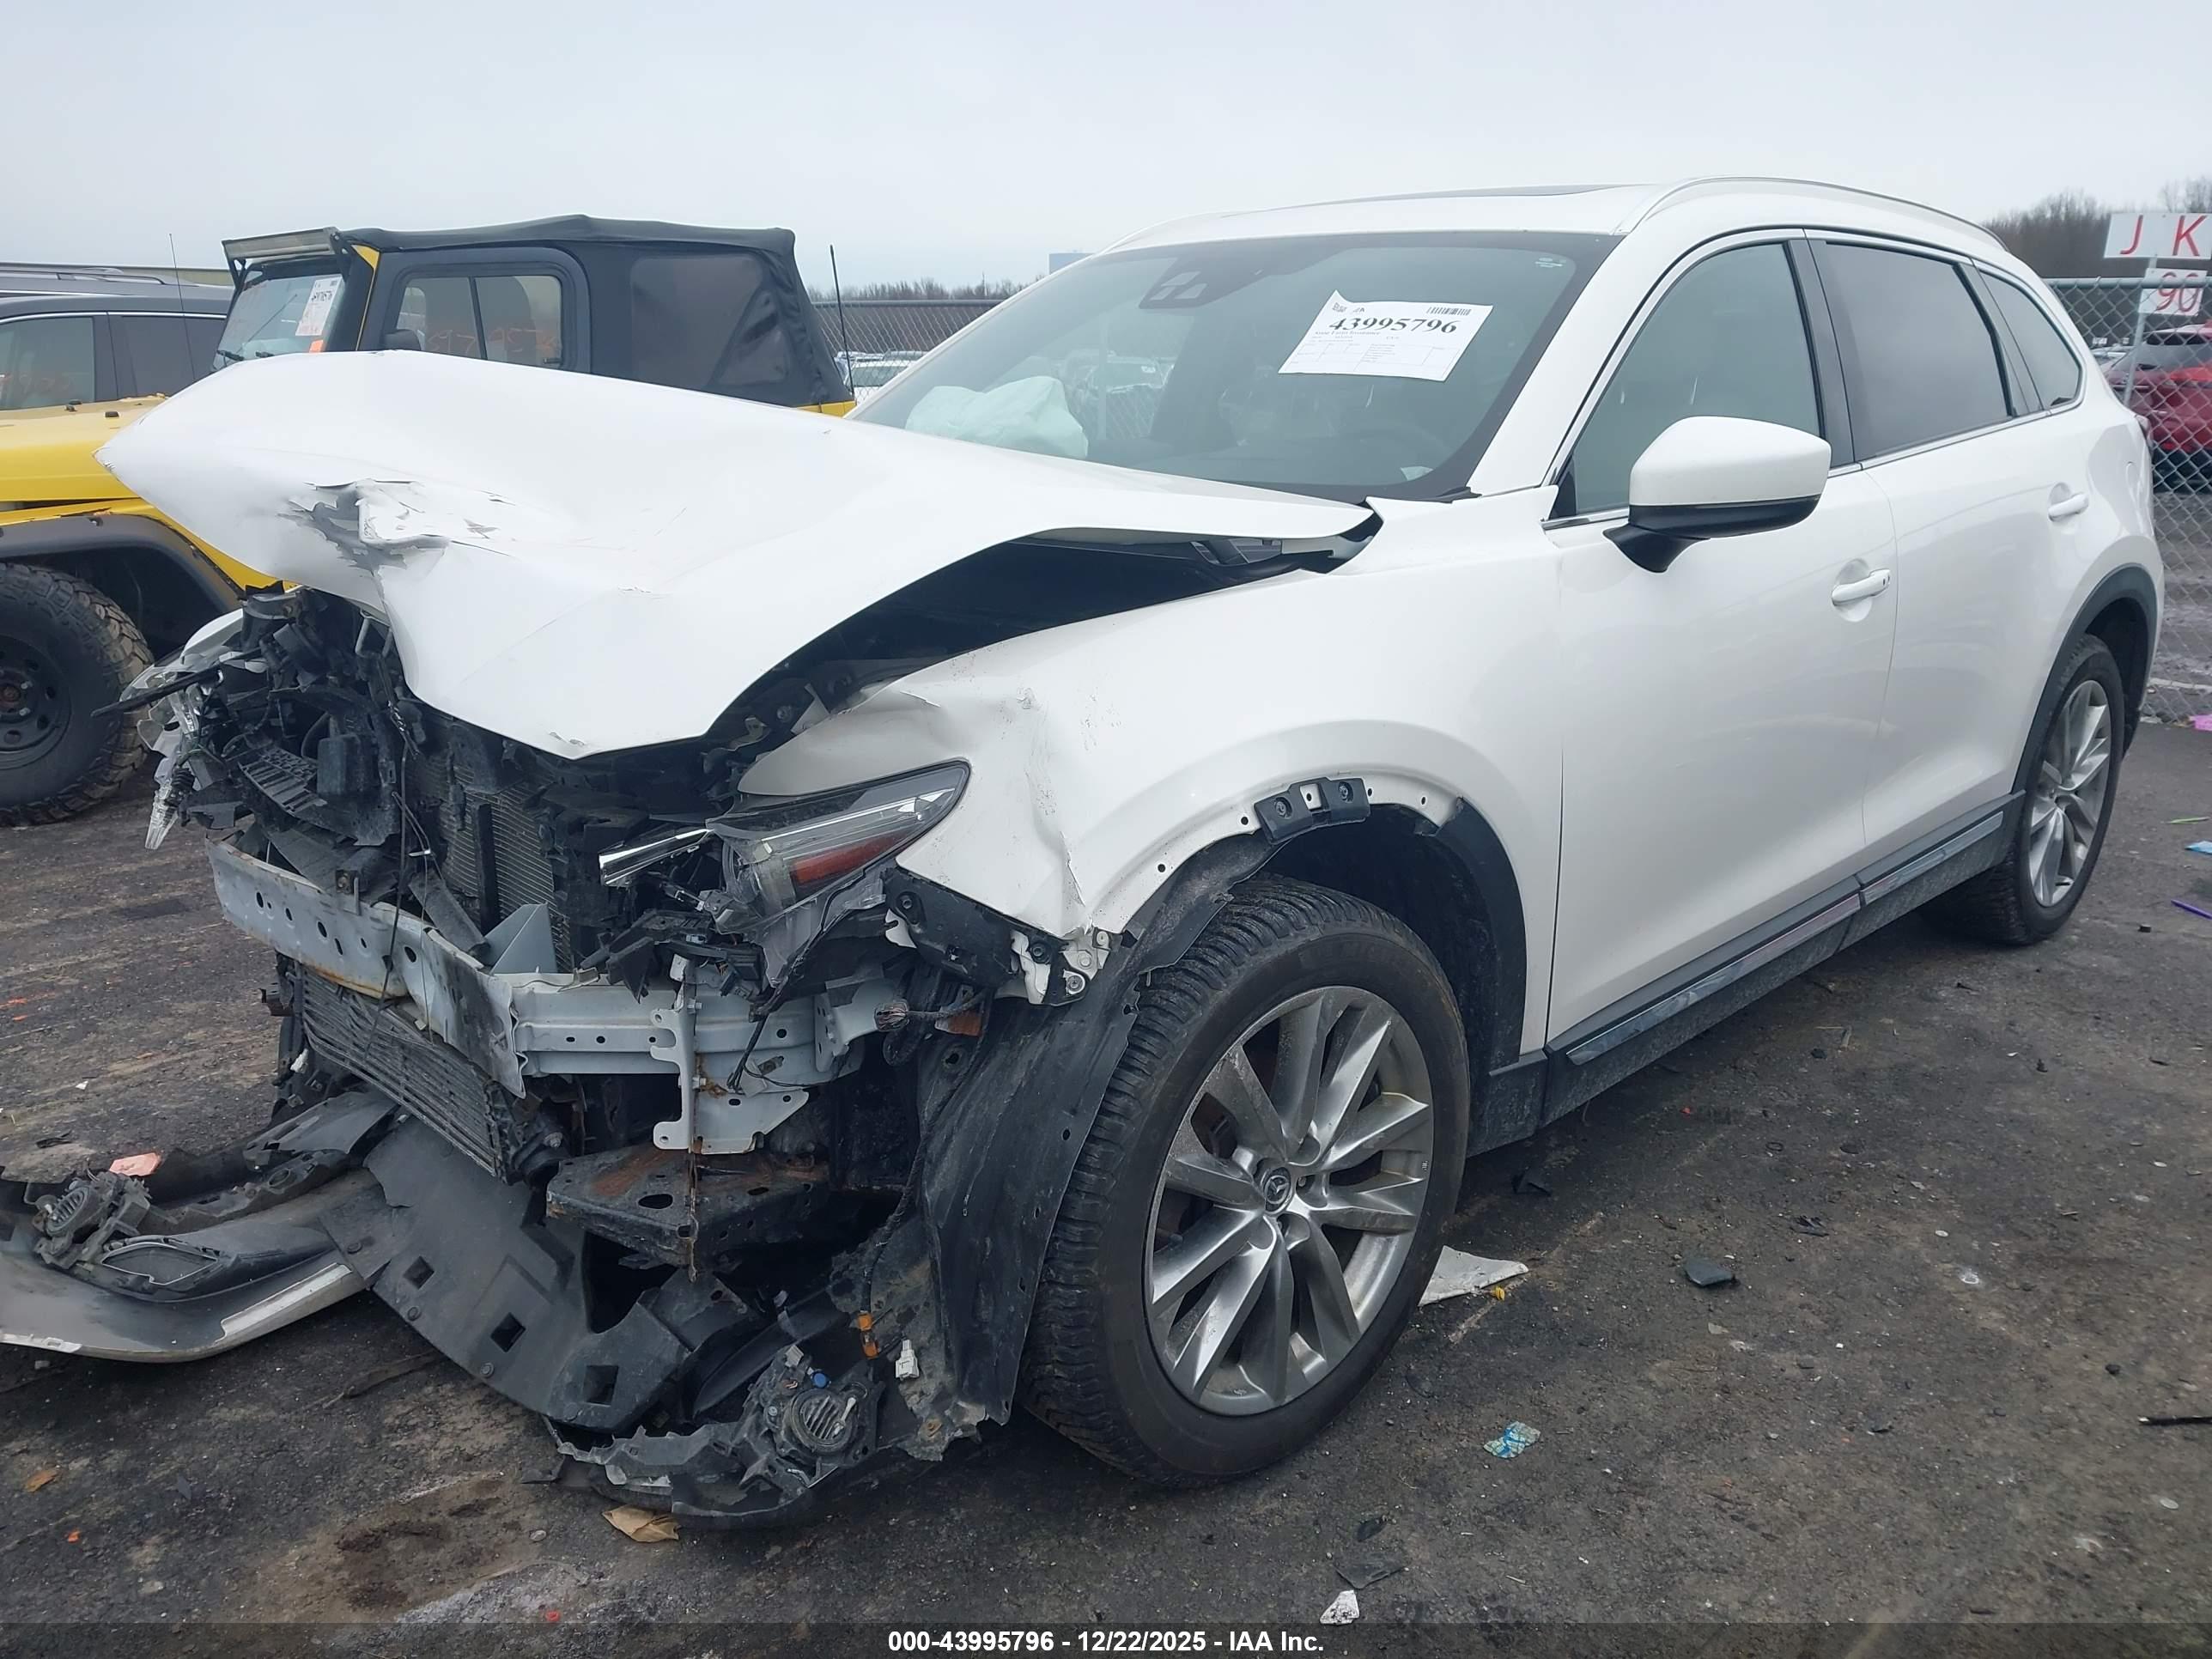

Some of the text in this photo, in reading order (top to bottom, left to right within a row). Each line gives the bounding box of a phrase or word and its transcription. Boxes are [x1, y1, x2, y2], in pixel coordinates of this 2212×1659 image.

[2119, 215, 2208, 256] J K
[2156, 271, 2199, 312] 90
[1328, 317, 1460, 333] 43995796
